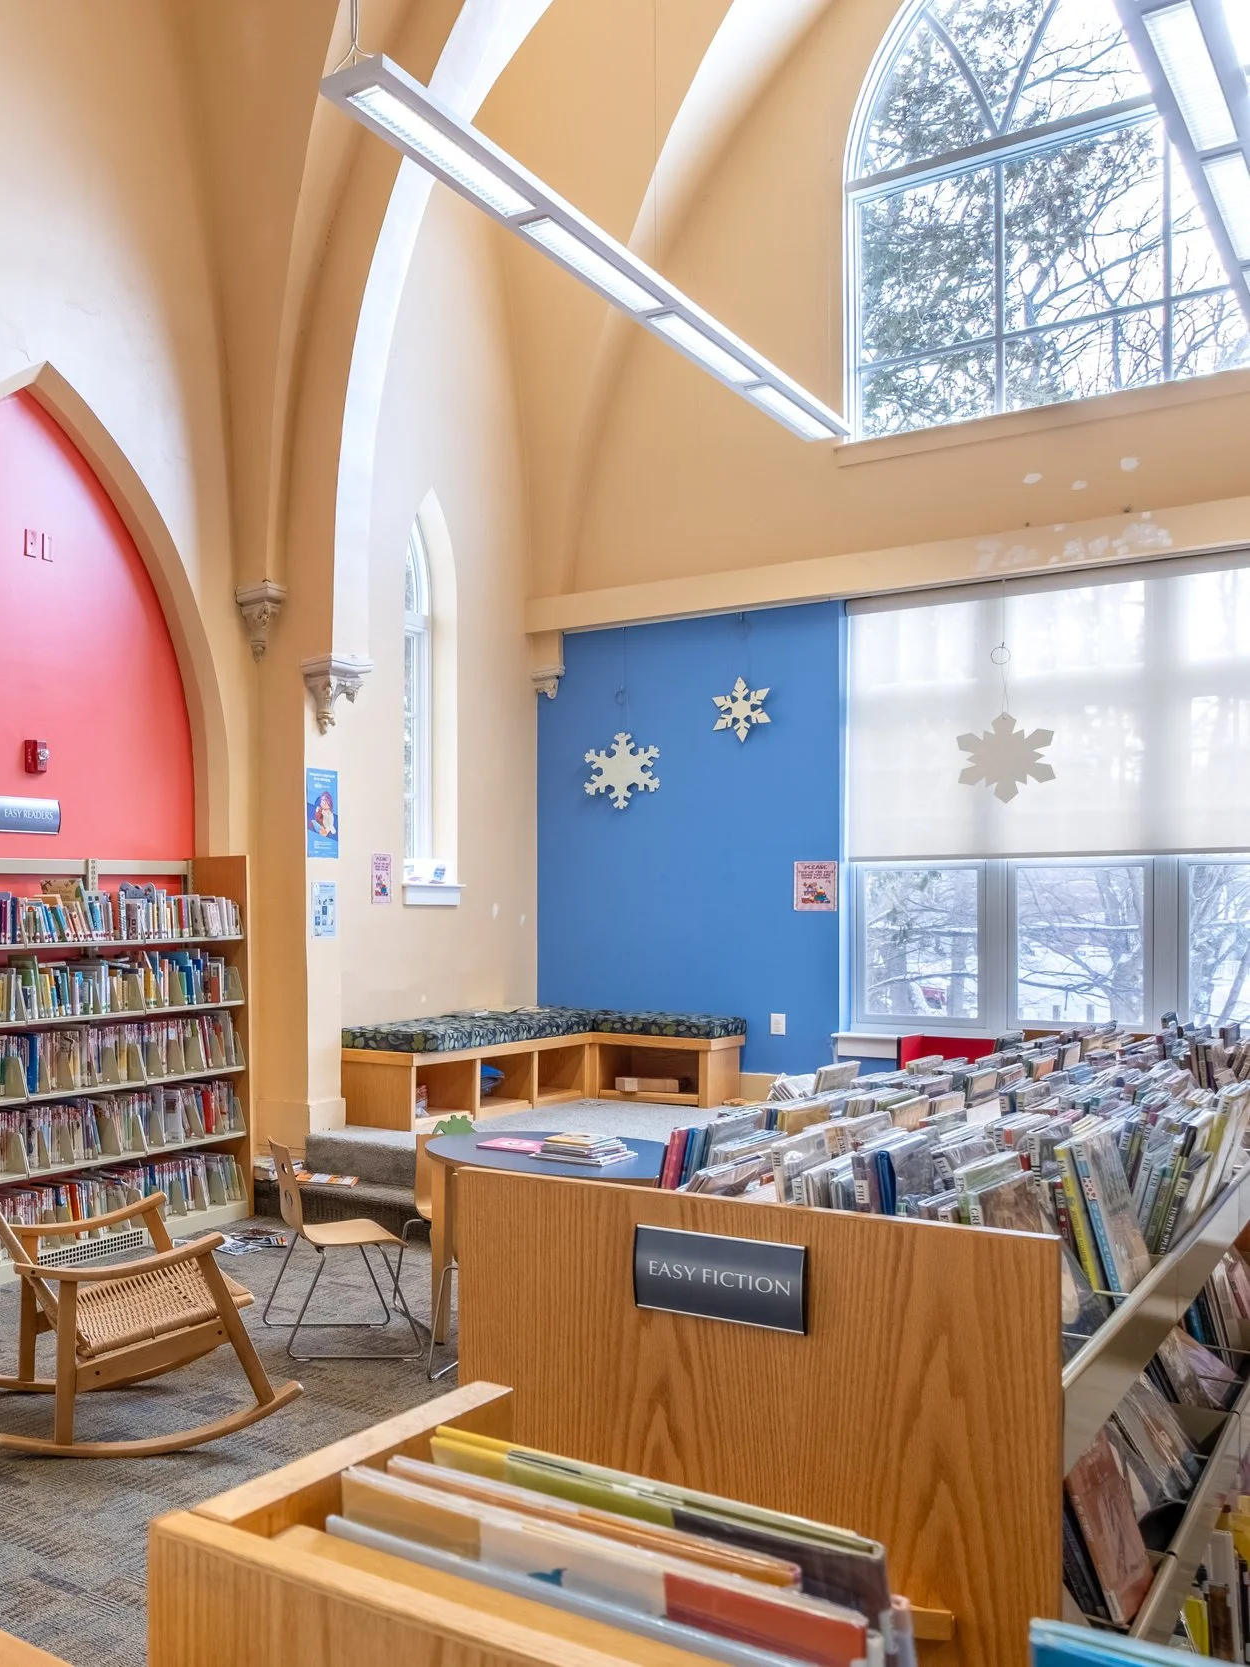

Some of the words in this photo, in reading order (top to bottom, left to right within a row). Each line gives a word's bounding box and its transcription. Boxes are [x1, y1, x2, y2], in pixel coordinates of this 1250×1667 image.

[4, 808, 22, 818] EASY
[23, 809, 54, 820] READERS
[1075, 1144, 1085, 1159] FAL
[937, 1161, 948, 1177] ELL
[1058, 1160, 1068, 1177] FAL
[1141, 1157, 1150, 1172] FER
[1150, 1172, 1159, 1187] FER
[1056, 1190, 1064, 1208] FAL
[1164, 1206, 1178, 1231] TURTLE
[1157, 1233, 1170, 1254] SPLAS
[649, 1260, 696, 1281] EASY
[702, 1268, 791, 1296] FICTION
